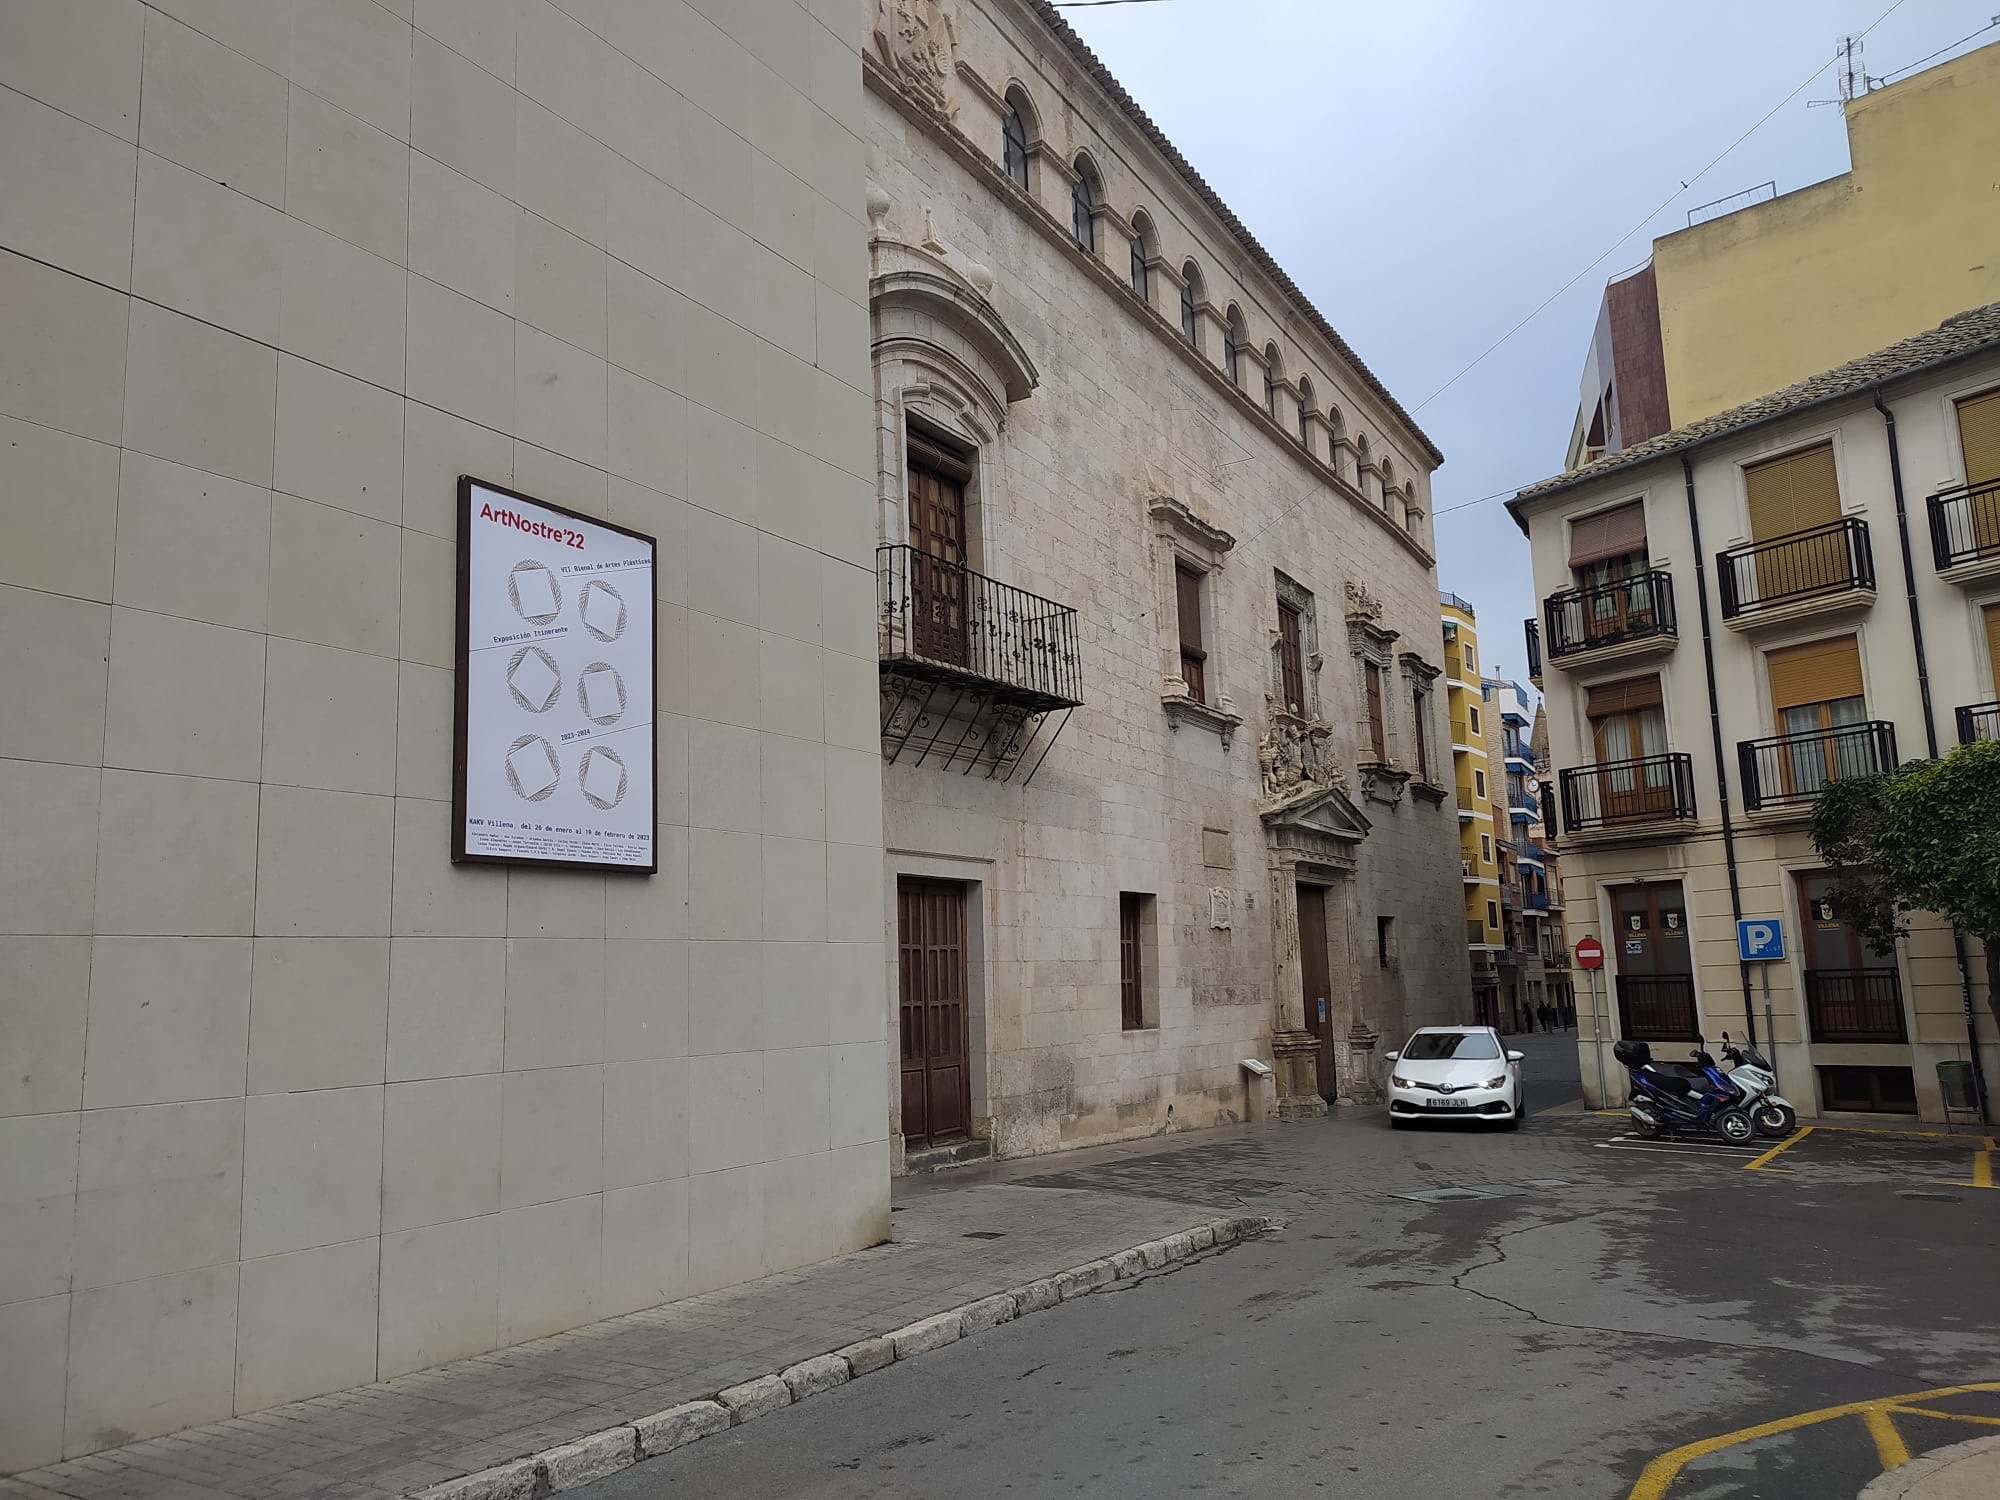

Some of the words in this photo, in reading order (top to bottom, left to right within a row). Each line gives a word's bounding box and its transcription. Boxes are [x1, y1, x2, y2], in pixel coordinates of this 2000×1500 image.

[480, 503, 585, 550] ArtNostre'22
[574, 563, 594, 572] Bienal
[494, 631, 531, 644] Exposición
[534, 626, 568, 638] Itinerante
[560, 728, 591, 741] 2023-2024
[604, 830, 626, 838] febrero
[1746, 924, 1772, 954] P
